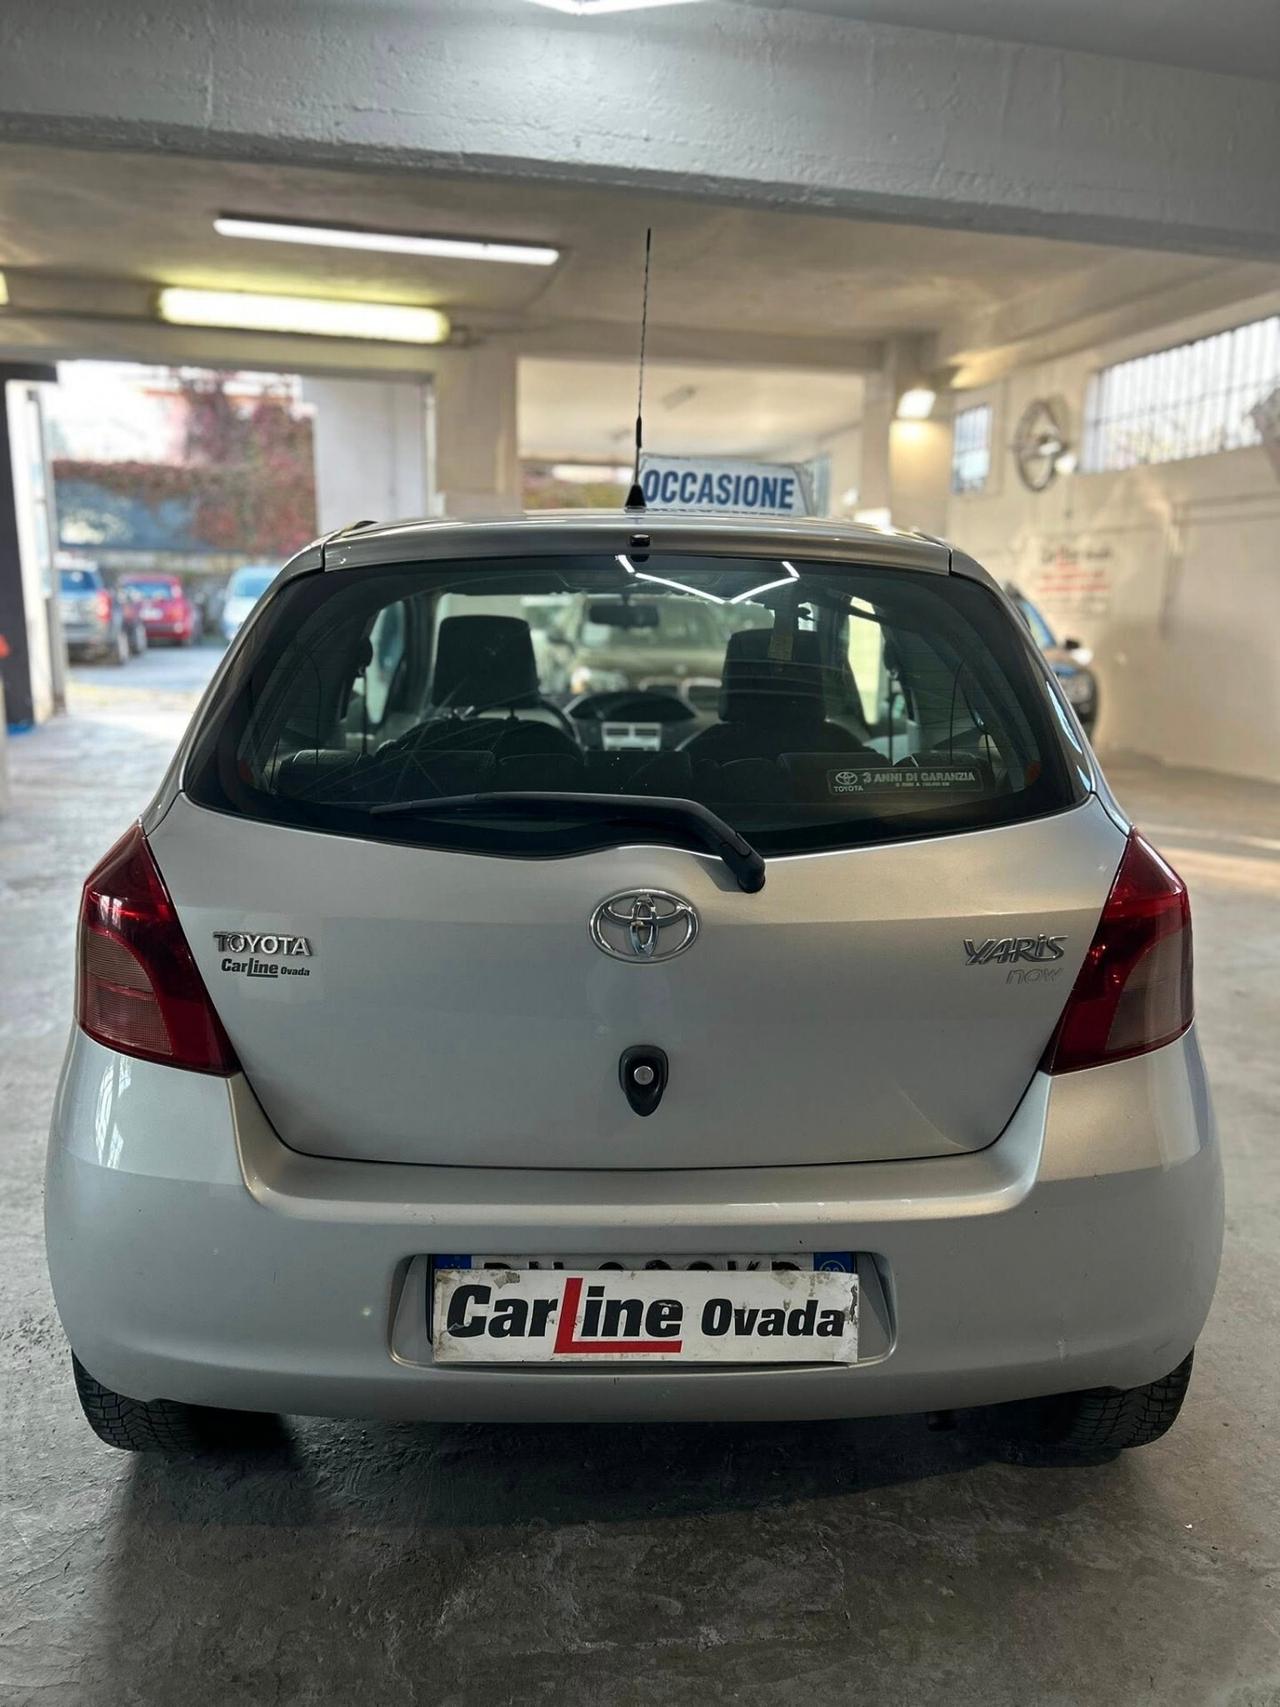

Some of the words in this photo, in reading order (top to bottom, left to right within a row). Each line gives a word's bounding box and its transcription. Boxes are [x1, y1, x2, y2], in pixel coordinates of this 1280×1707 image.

[643, 469, 794, 509] OCCASIONE
[863, 772, 872, 783] 3
[874, 772, 902, 782] ANNI
[906, 772, 918, 781] DI
[921, 771, 976, 782] GARANZIA
[833, 785, 864, 793] TOYOTA
[213, 932, 313, 956] TOYOTA
[221, 958, 279, 978] CarLine
[280, 966, 310, 977] Ovada
[447, 1277, 683, 1354] CarLine
[701, 1299, 846, 1337] Ovada
